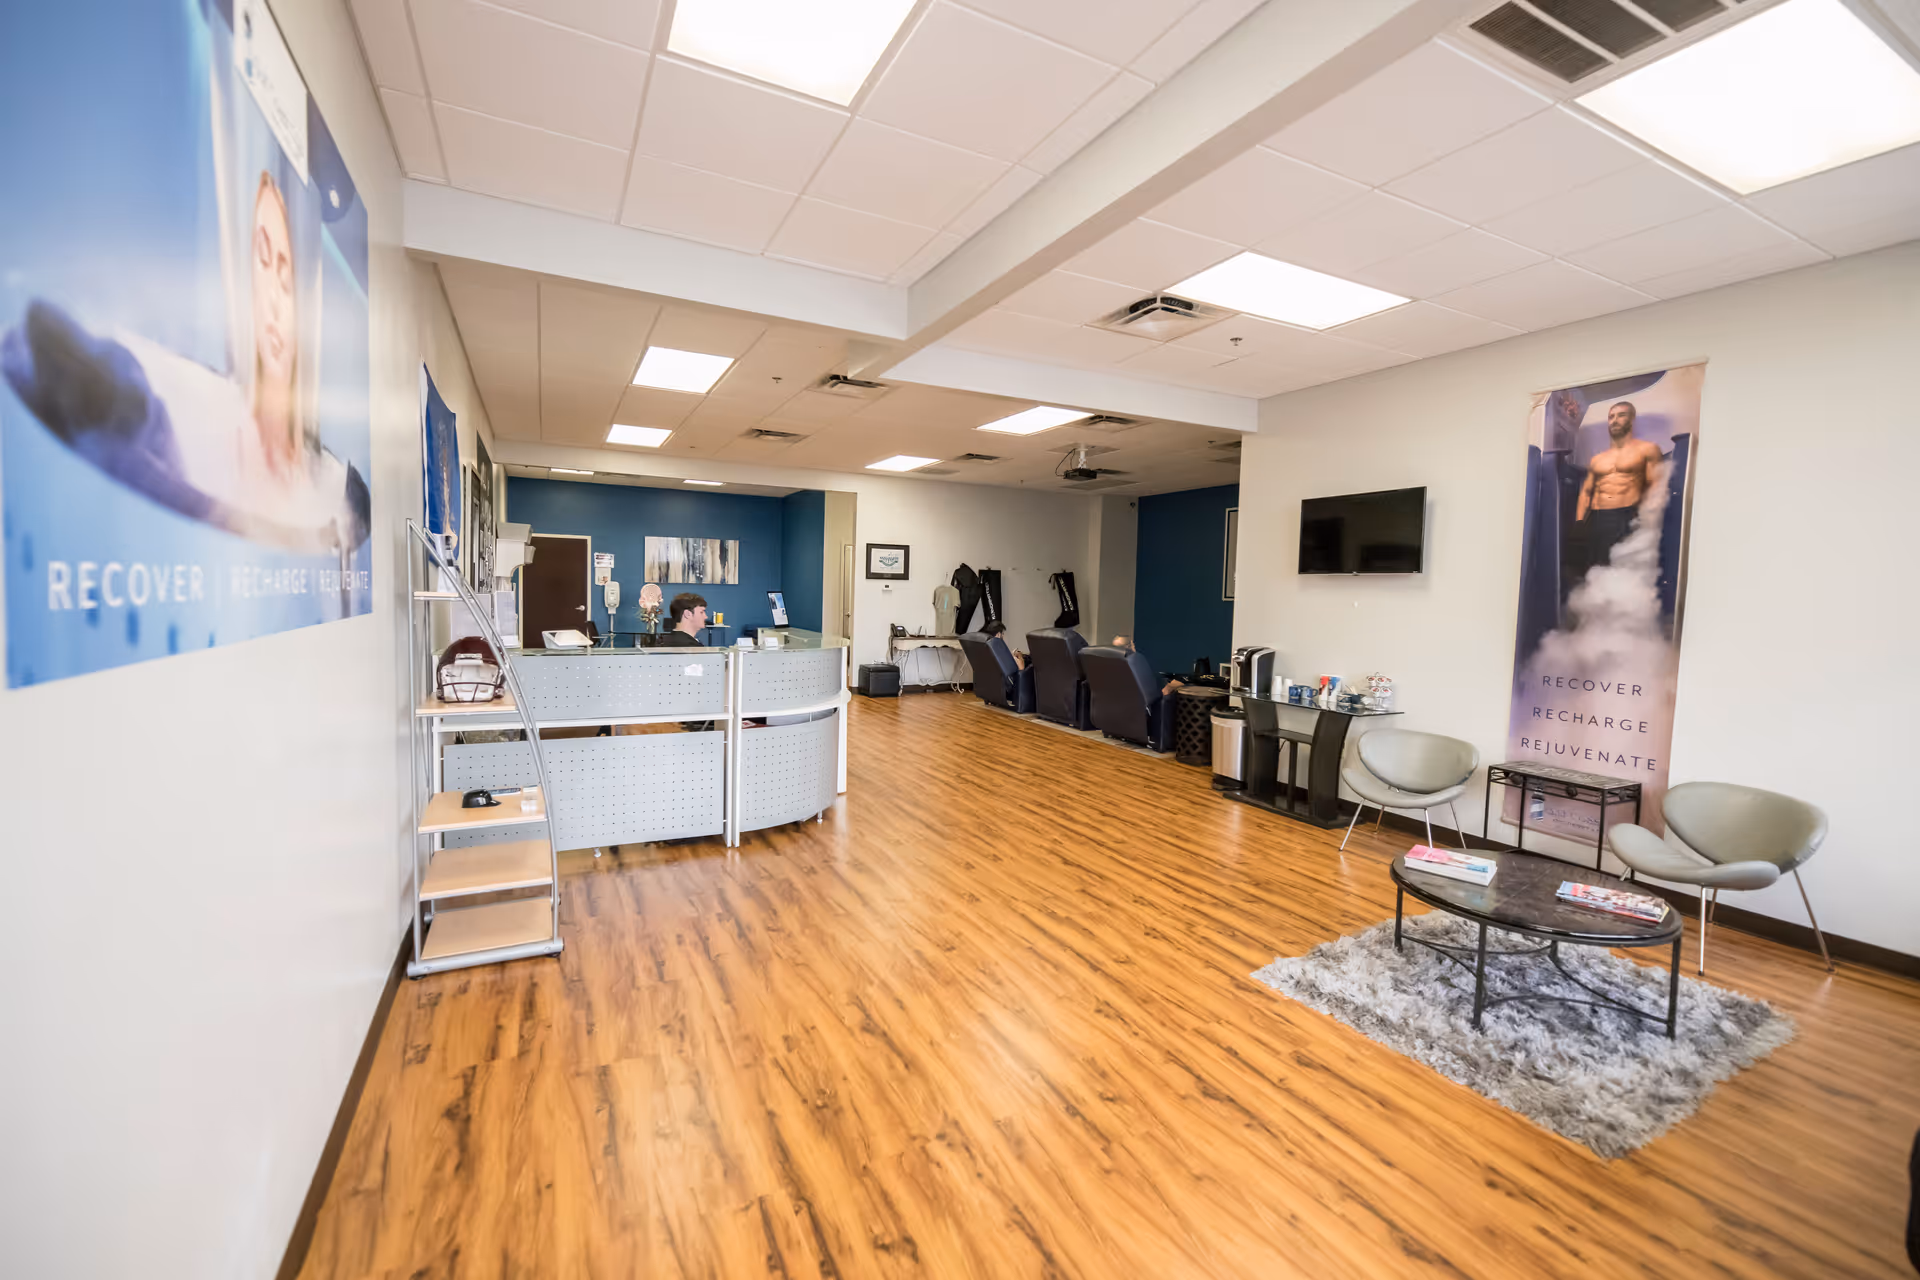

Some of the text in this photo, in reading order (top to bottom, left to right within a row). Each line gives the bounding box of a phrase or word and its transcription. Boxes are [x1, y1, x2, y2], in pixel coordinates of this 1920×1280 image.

[48, 561, 369, 610] RECOVER RECHARGE REJUVENATE
[1542, 675, 1642, 696] RECOVER
[1532, 706, 1648, 733] RECHARGE
[1521, 737, 1656, 771] REJUVENATE
